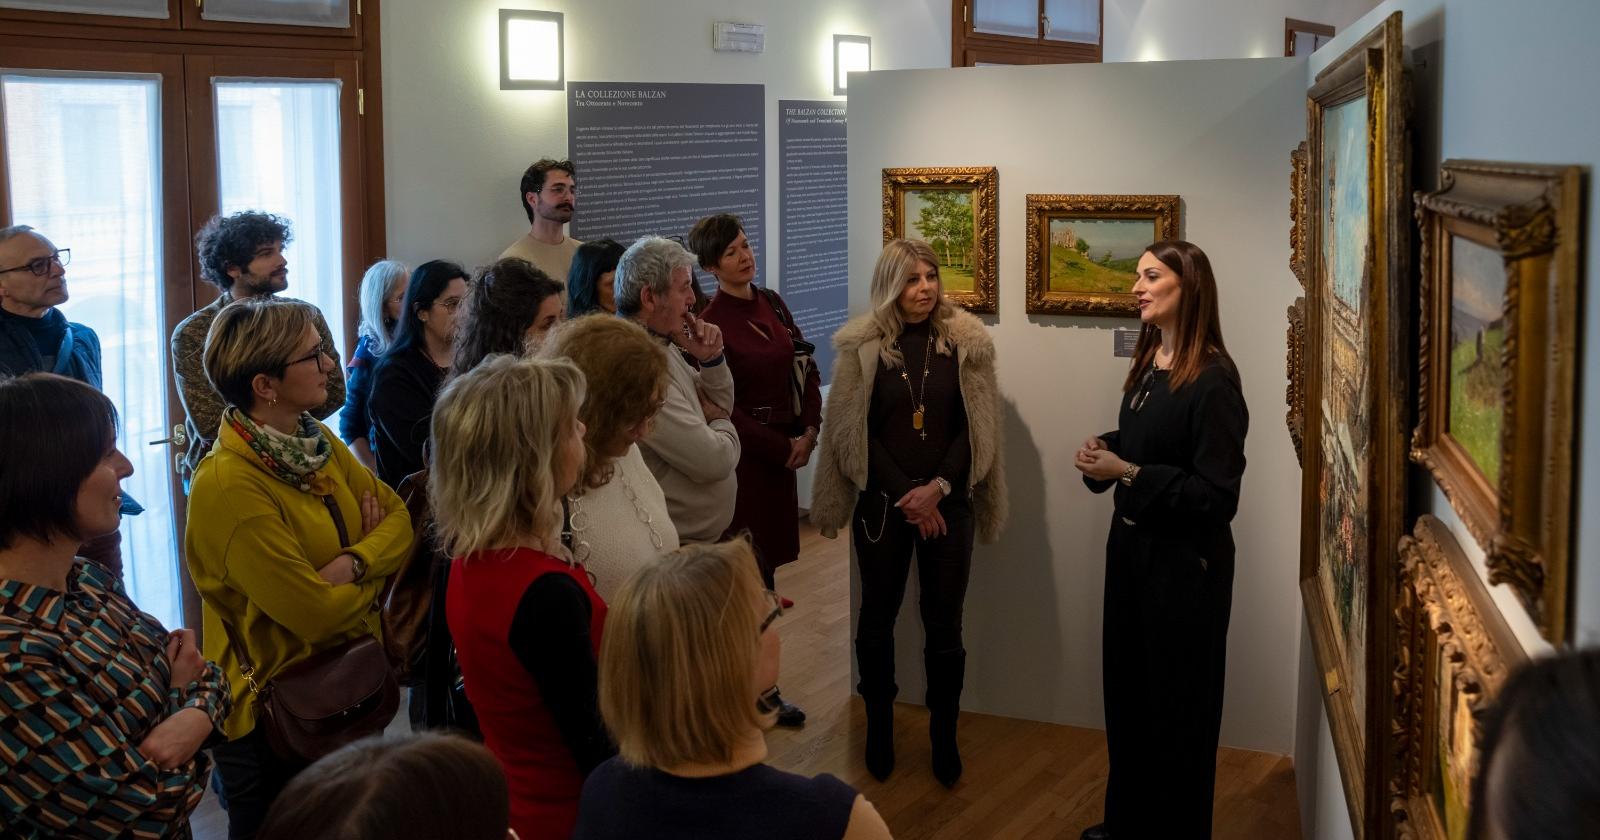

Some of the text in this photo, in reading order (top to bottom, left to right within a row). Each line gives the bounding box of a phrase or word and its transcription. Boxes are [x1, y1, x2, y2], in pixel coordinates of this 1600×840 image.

[575, 90, 667, 99] LA COLLEZIONE BALZAN
[785, 108, 846, 116] THE BALZAN COLLECTION
